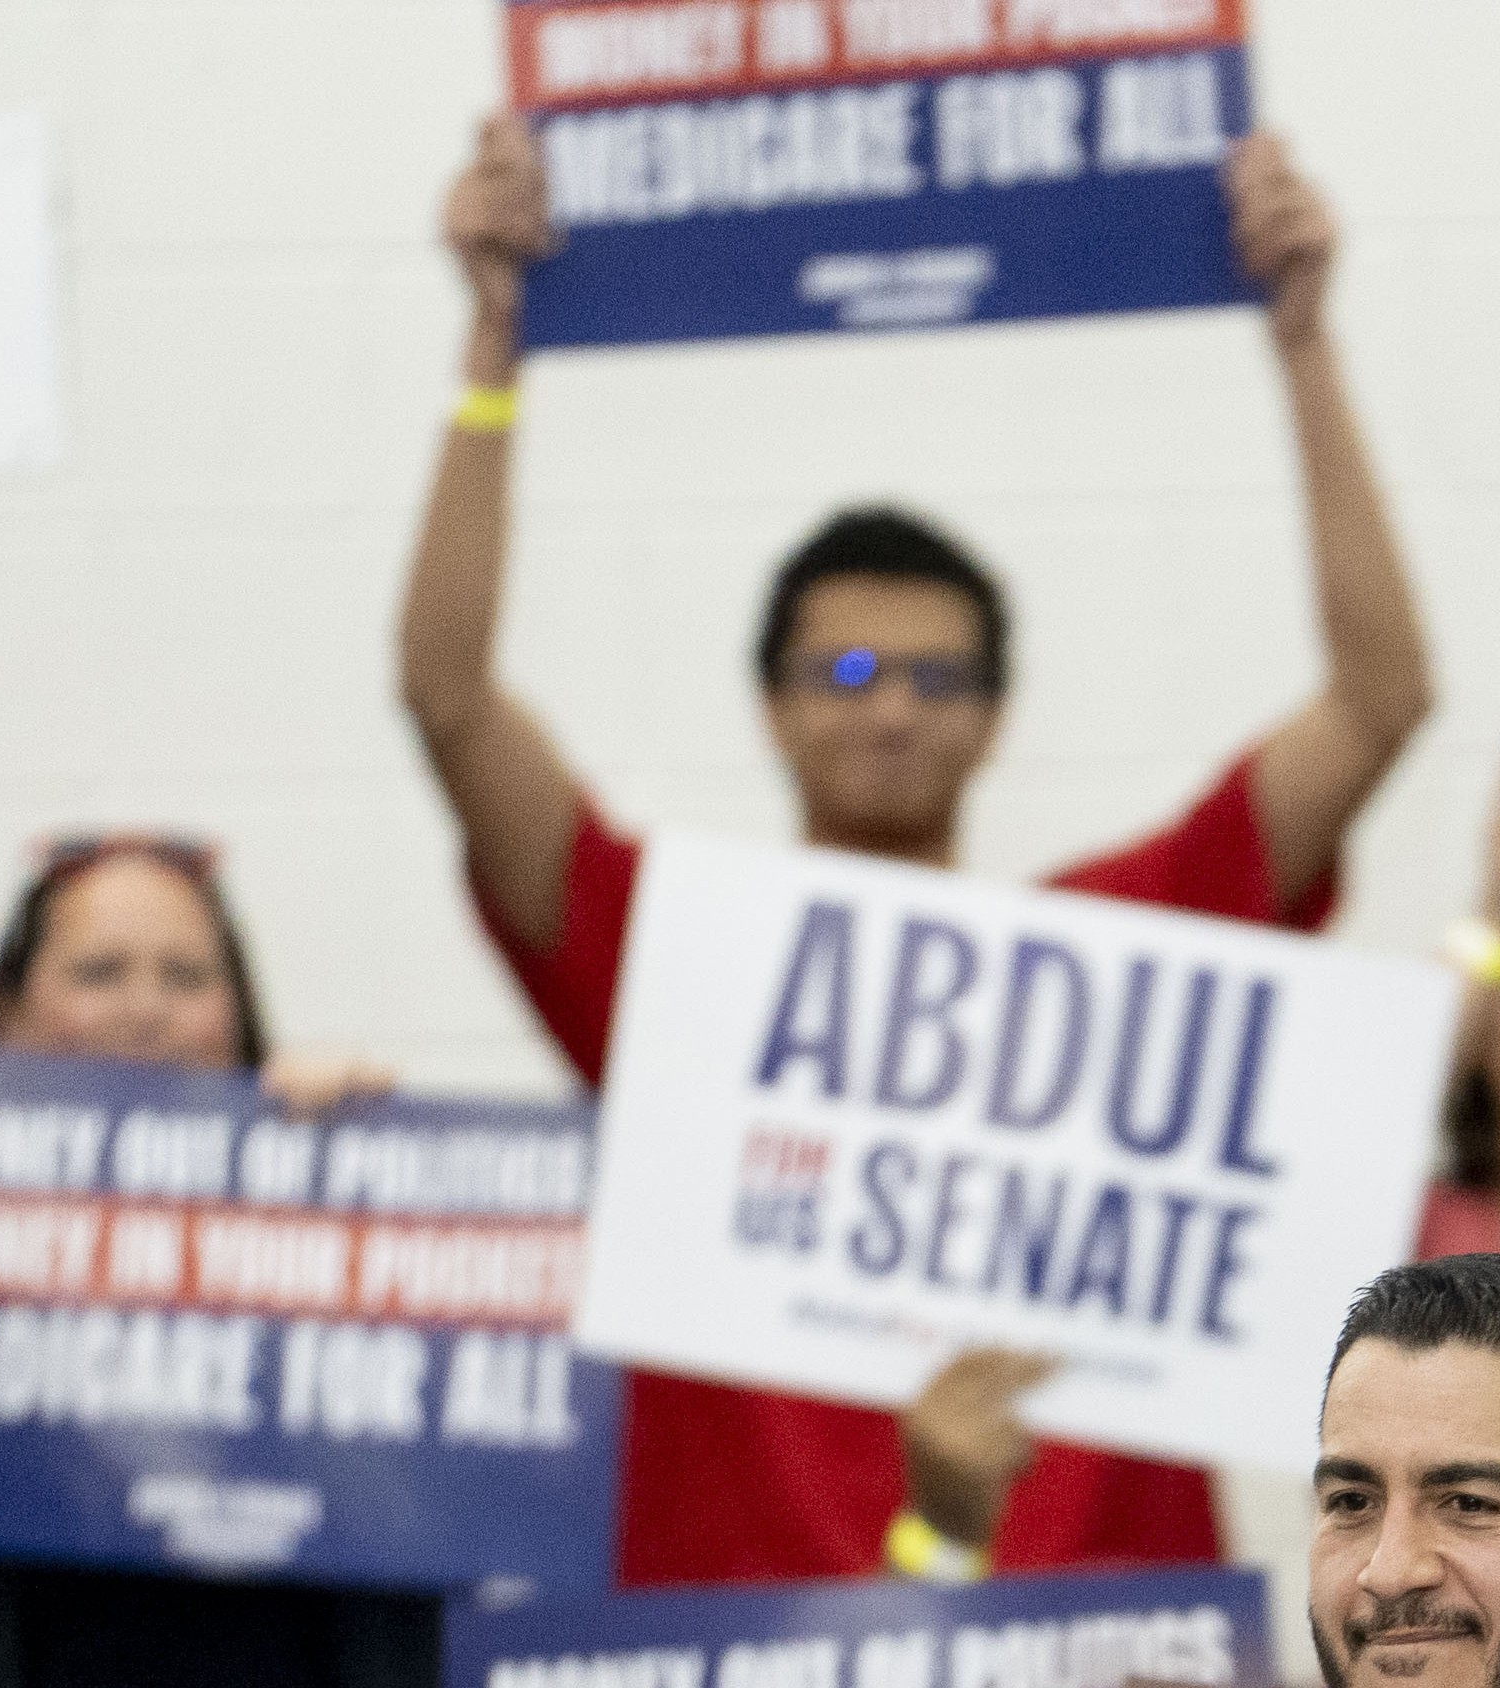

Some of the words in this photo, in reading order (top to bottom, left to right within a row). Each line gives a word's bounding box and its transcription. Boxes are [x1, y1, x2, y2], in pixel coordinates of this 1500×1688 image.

[937, 70, 1084, 191] FOR
[750, 898, 1281, 1178] ABDUL
[845, 1137, 1260, 1345] SENATE
[280, 1320, 428, 1444] FOR
[441, 1327, 577, 1450] ALL
